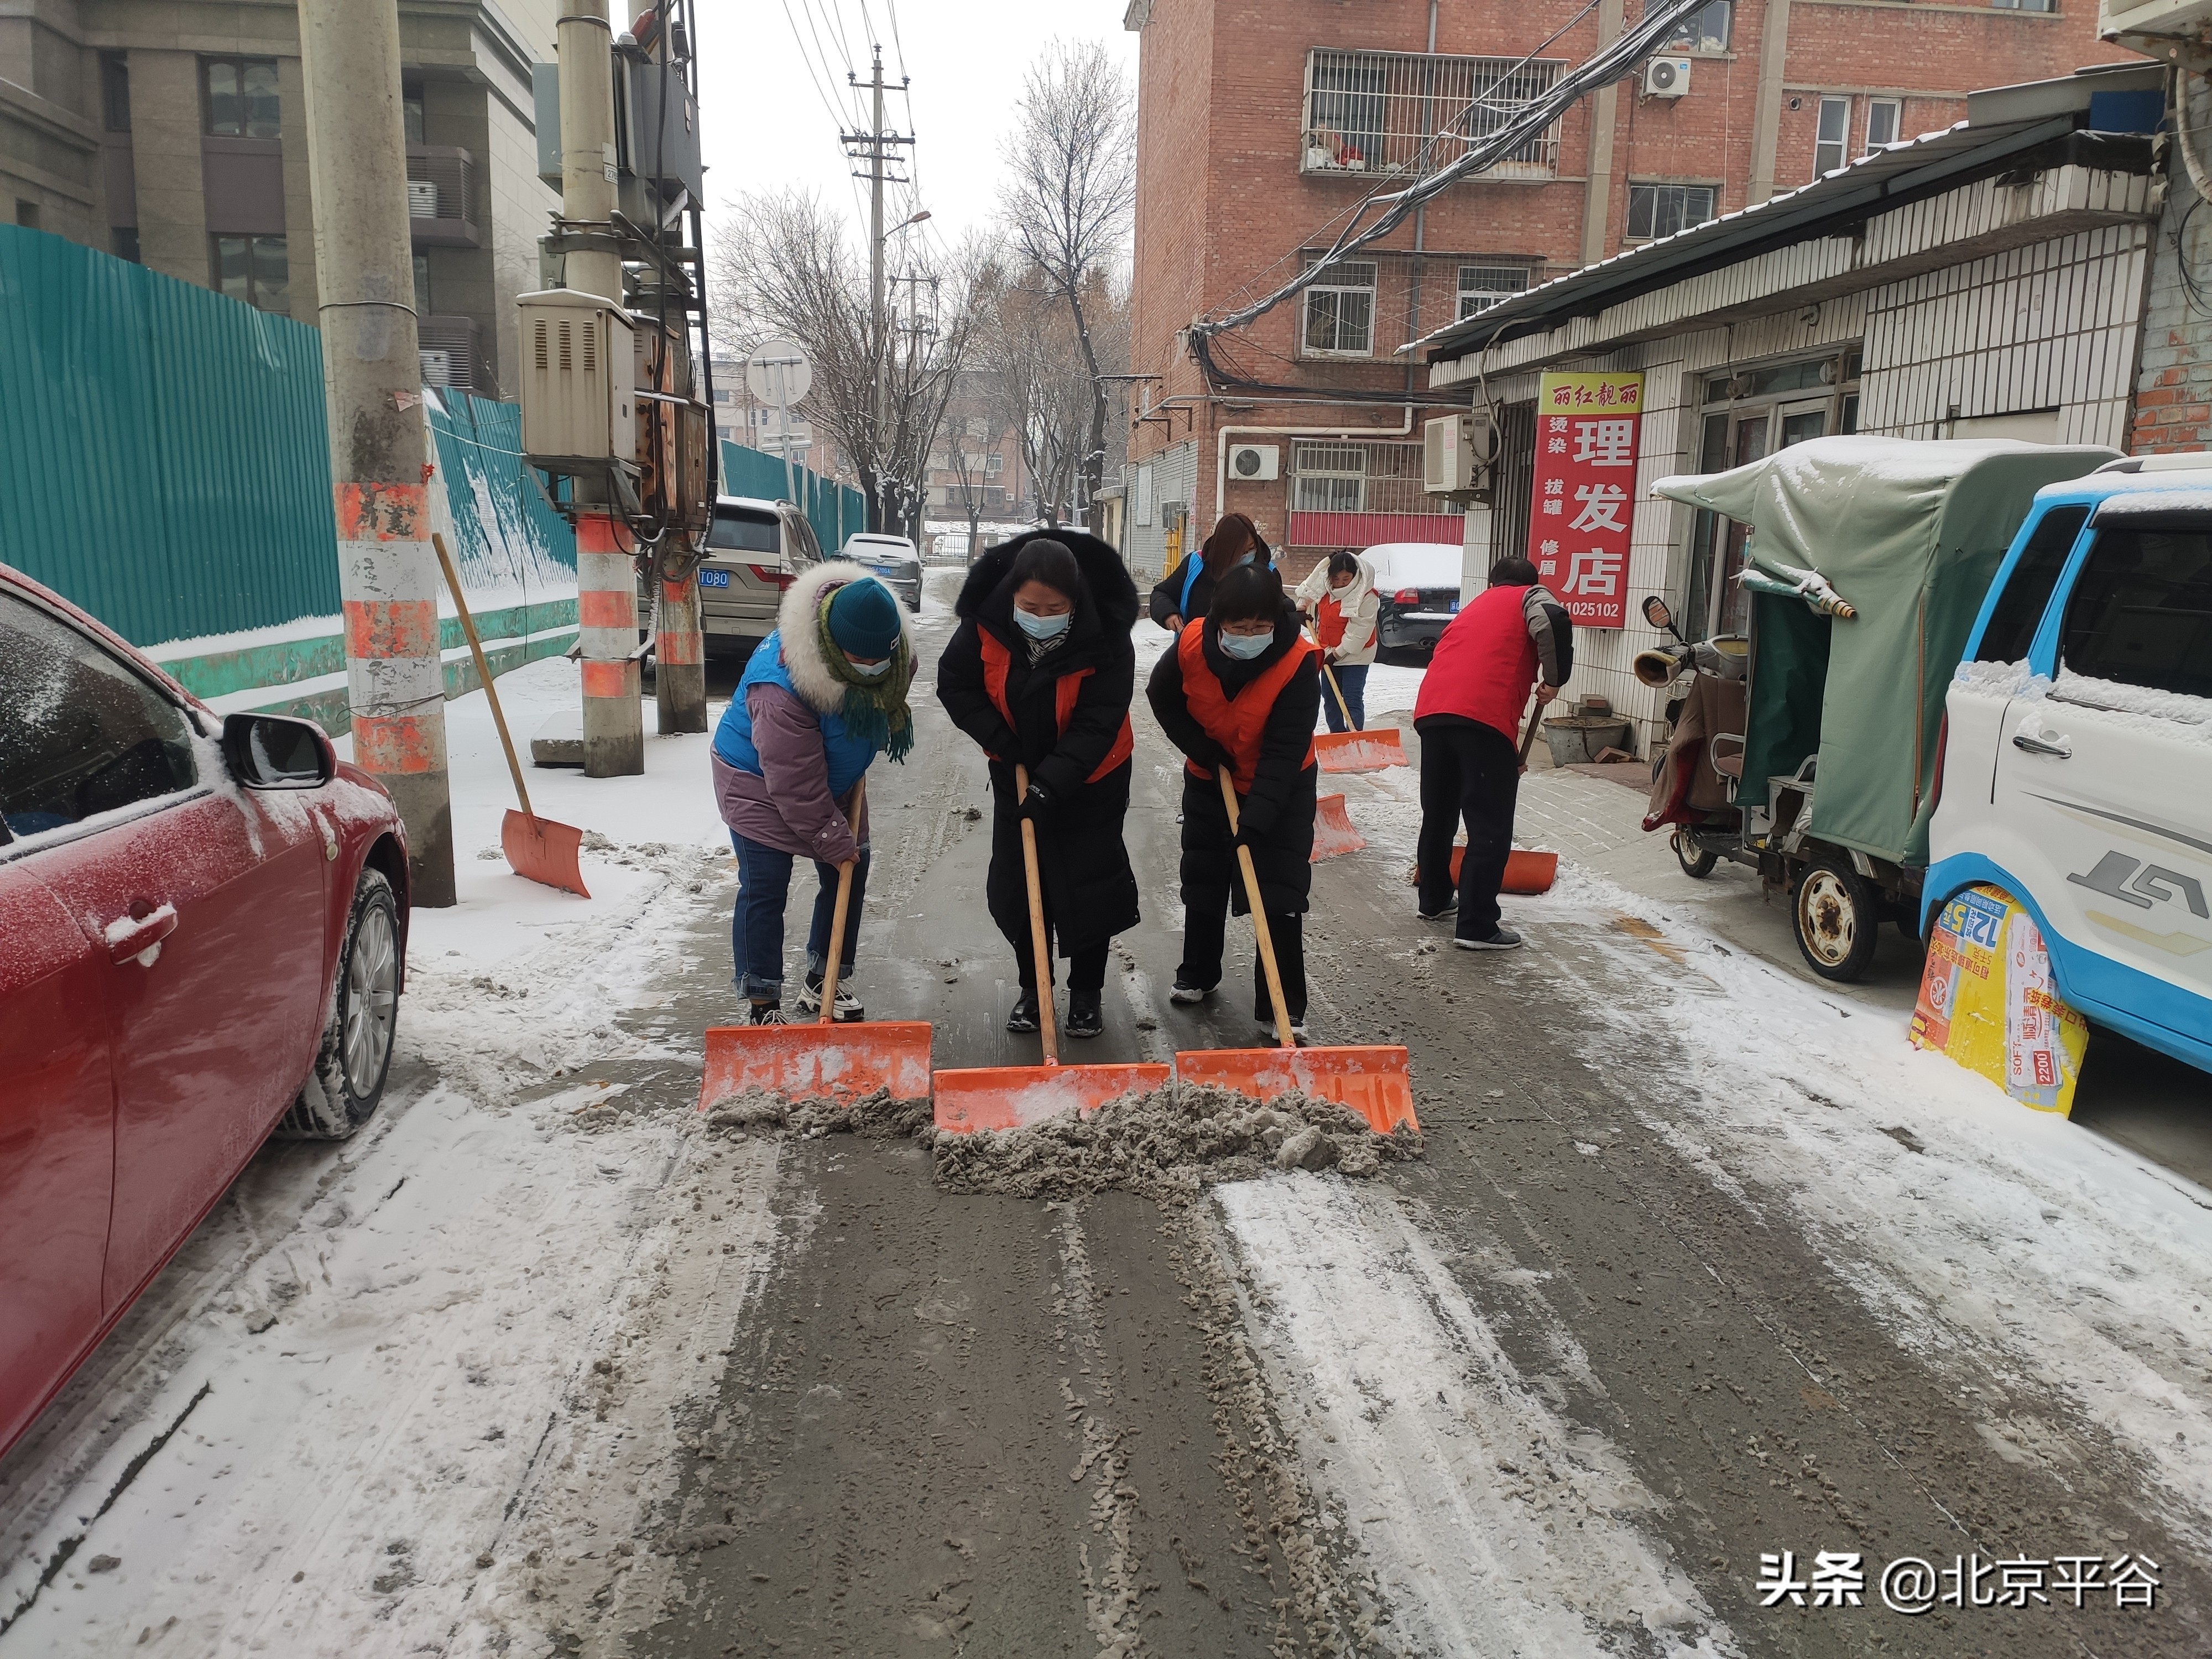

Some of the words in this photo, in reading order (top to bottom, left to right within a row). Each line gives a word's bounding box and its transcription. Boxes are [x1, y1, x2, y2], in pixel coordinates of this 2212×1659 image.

[1552, 381, 1640, 409] 丽红靓丽
[1547, 416, 1568, 454] 烫染
[1543, 478, 1564, 515] 拔罐
[1561, 419, 1634, 596] 理发店
[1537, 539, 1560, 576] 修眉
[1972, 911, 1997, 948] 12
[1973, 947, 1992, 964] 5千克
[2039, 1053, 2051, 1083] 2200
